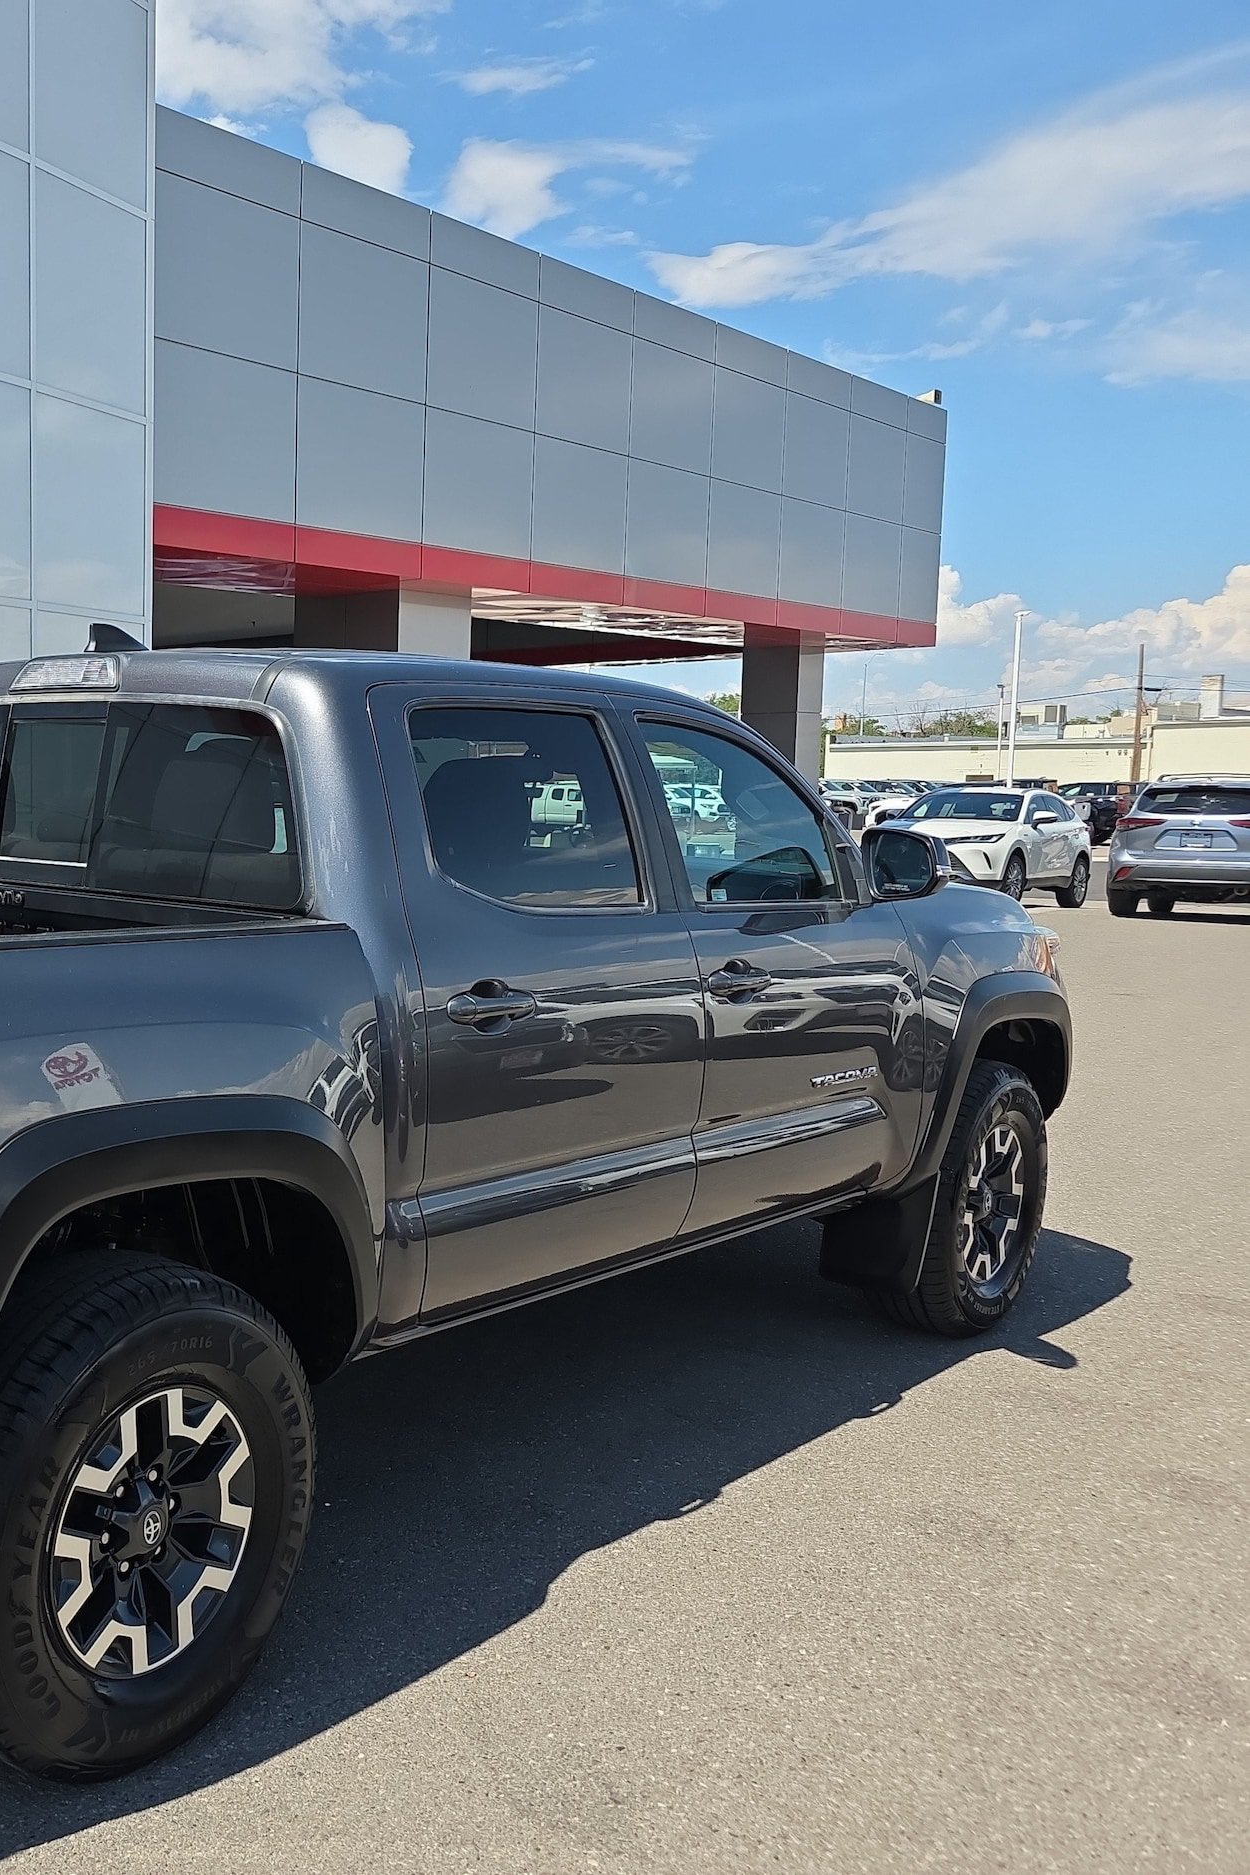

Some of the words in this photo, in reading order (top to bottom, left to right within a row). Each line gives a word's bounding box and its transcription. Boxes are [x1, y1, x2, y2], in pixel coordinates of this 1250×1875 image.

[810, 1065, 878, 1089] TACOMA
[9, 1455, 62, 1721] GOODYEAR
[270, 1371, 307, 1598] WRANGLER
